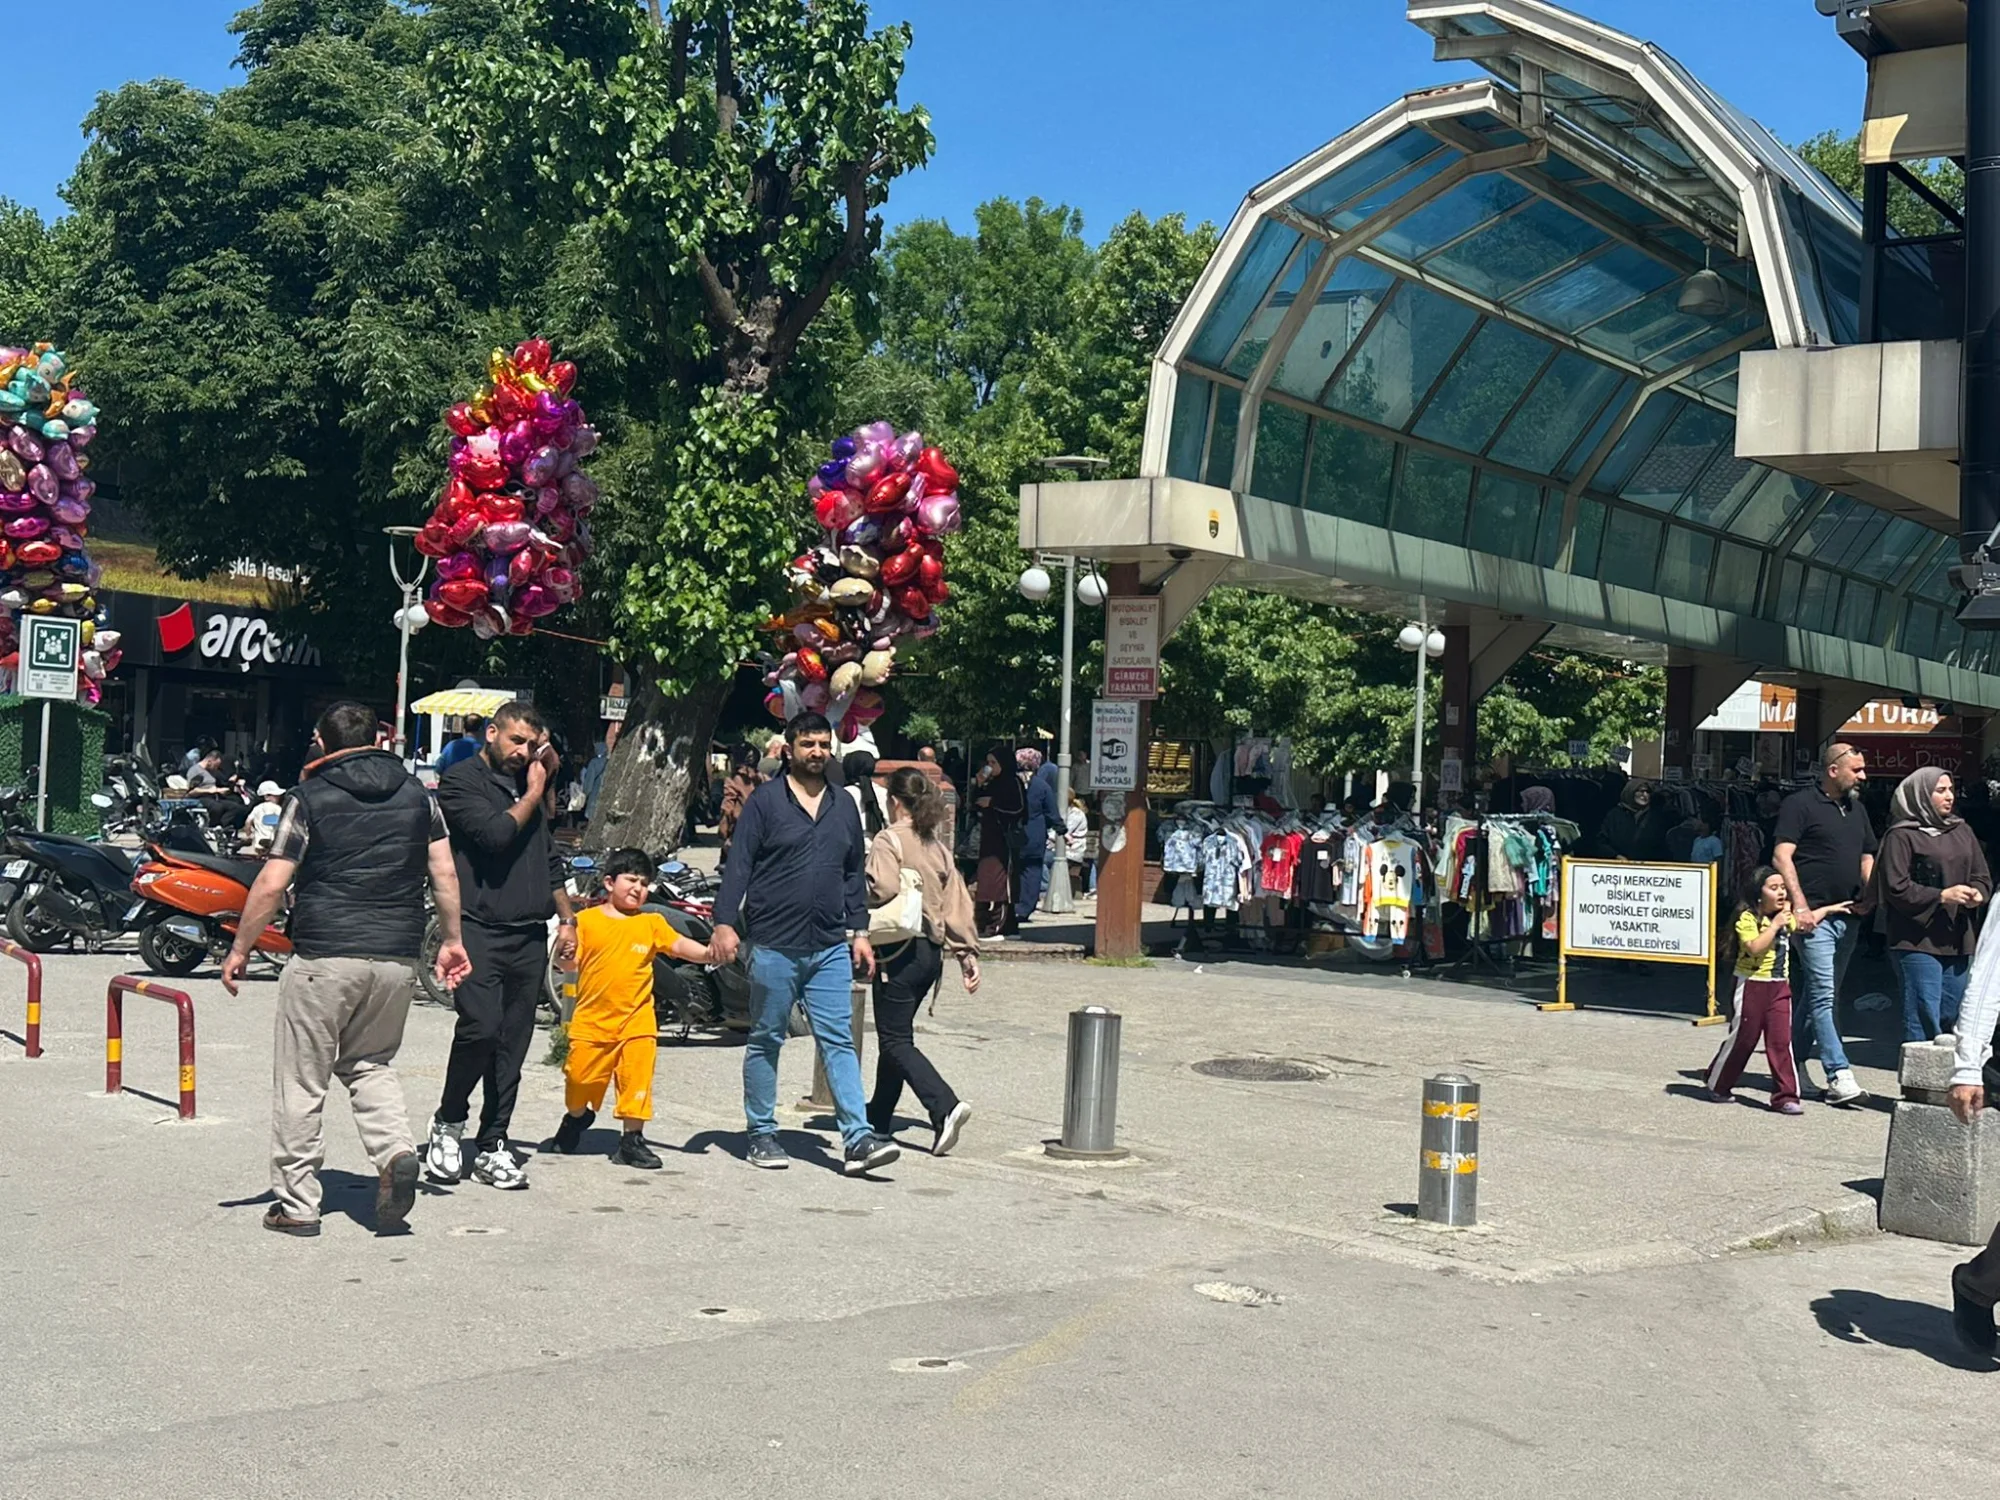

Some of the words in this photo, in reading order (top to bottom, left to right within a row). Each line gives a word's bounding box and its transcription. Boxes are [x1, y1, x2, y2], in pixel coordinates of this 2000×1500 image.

[228, 556, 257, 580] şkla
[1094, 776, 1132, 785] NOKTASI
[1591, 873, 1622, 887] ÇARŞI
[1624, 875, 1683, 888] MERKEZİNE
[1607, 887, 1651, 902] BİSİKLET
[1653, 894, 1665, 903] ve
[1579, 903, 1650, 917] MOTORSİKLET
[1651, 905, 1695, 919] GİRMESİ
[1609, 920, 1661, 933] YASAKTIR.
[1591, 934, 1625, 947] İNEGÖL
[1627, 938, 1681, 950] BELEDİYESİ
